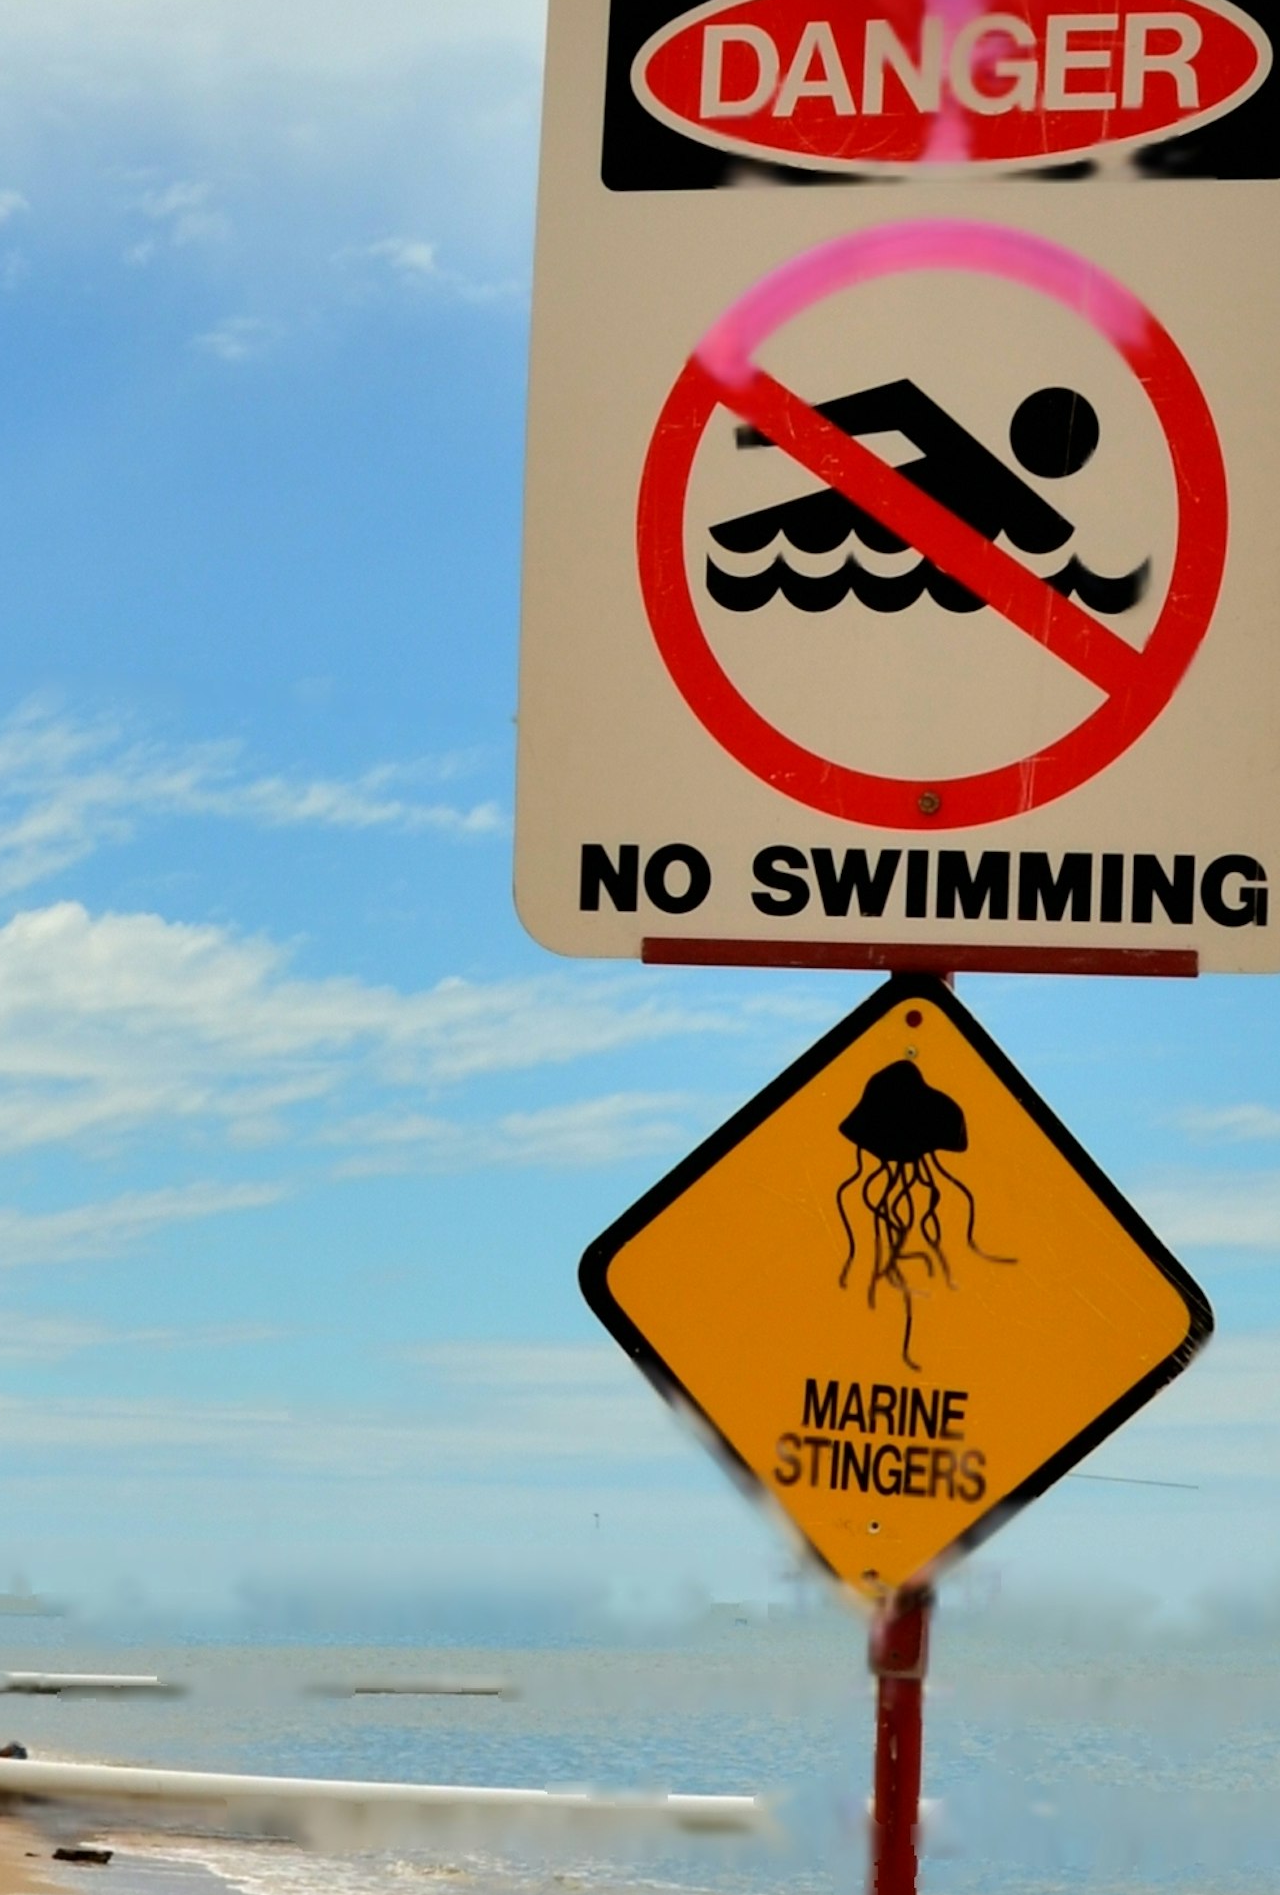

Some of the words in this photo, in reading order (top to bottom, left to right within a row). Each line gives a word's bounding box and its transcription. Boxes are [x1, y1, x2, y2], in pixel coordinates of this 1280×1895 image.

[699, 12, 1203, 119] DANGER
[579, 843, 712, 915] NO
[750, 844, 1269, 928] SWIMMING
[801, 1377, 969, 1441] MARINE
[773, 1432, 987, 1504] STINGERS
